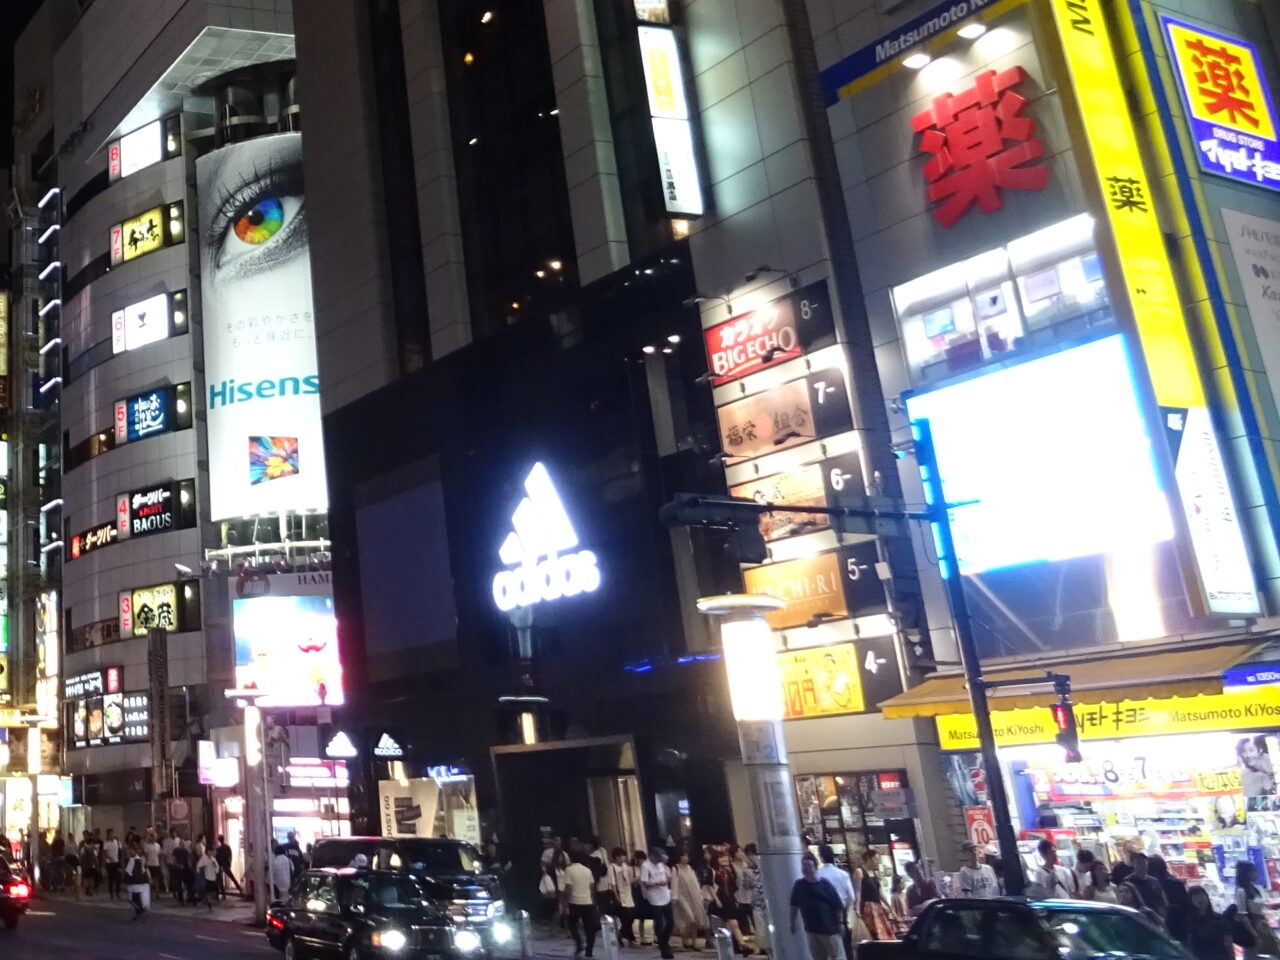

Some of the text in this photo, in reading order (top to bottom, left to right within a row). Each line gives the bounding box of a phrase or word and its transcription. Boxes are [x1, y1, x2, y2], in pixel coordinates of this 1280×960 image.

[875, 3, 968, 63] Matsumoto
[1186, 38, 1260, 129] 薬
[1213, 127, 1265, 151] DRUG STORE
[1106, 176, 1149, 214] 薬
[713, 326, 796, 377] BIG ECHO
[133, 513, 172, 534] BAGUS
[1168, 706, 1242, 724] Matsumoto
[948, 722, 1045, 741] Matsuto KiYoshi
